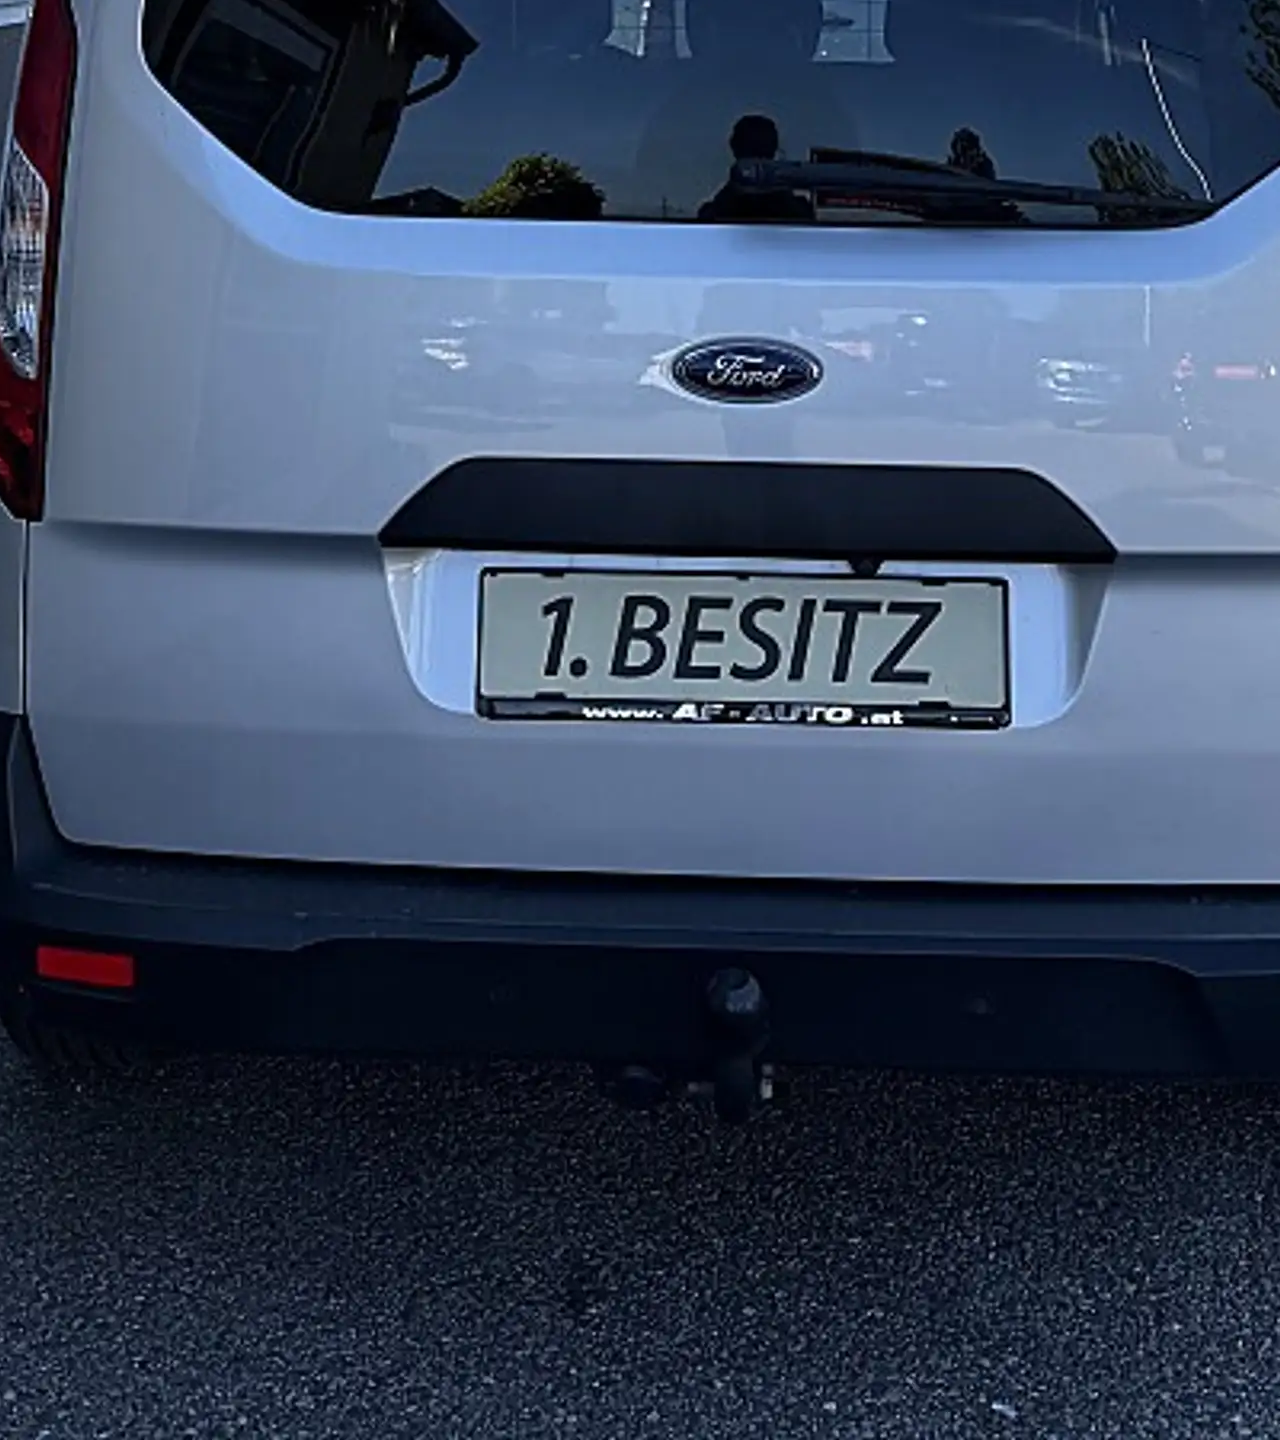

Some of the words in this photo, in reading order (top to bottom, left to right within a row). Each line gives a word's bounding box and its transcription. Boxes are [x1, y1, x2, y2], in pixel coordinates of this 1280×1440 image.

[706, 354, 787, 387] Ford
[540, 596, 588, 678] 1.
[609, 595, 943, 686] BESITZ
